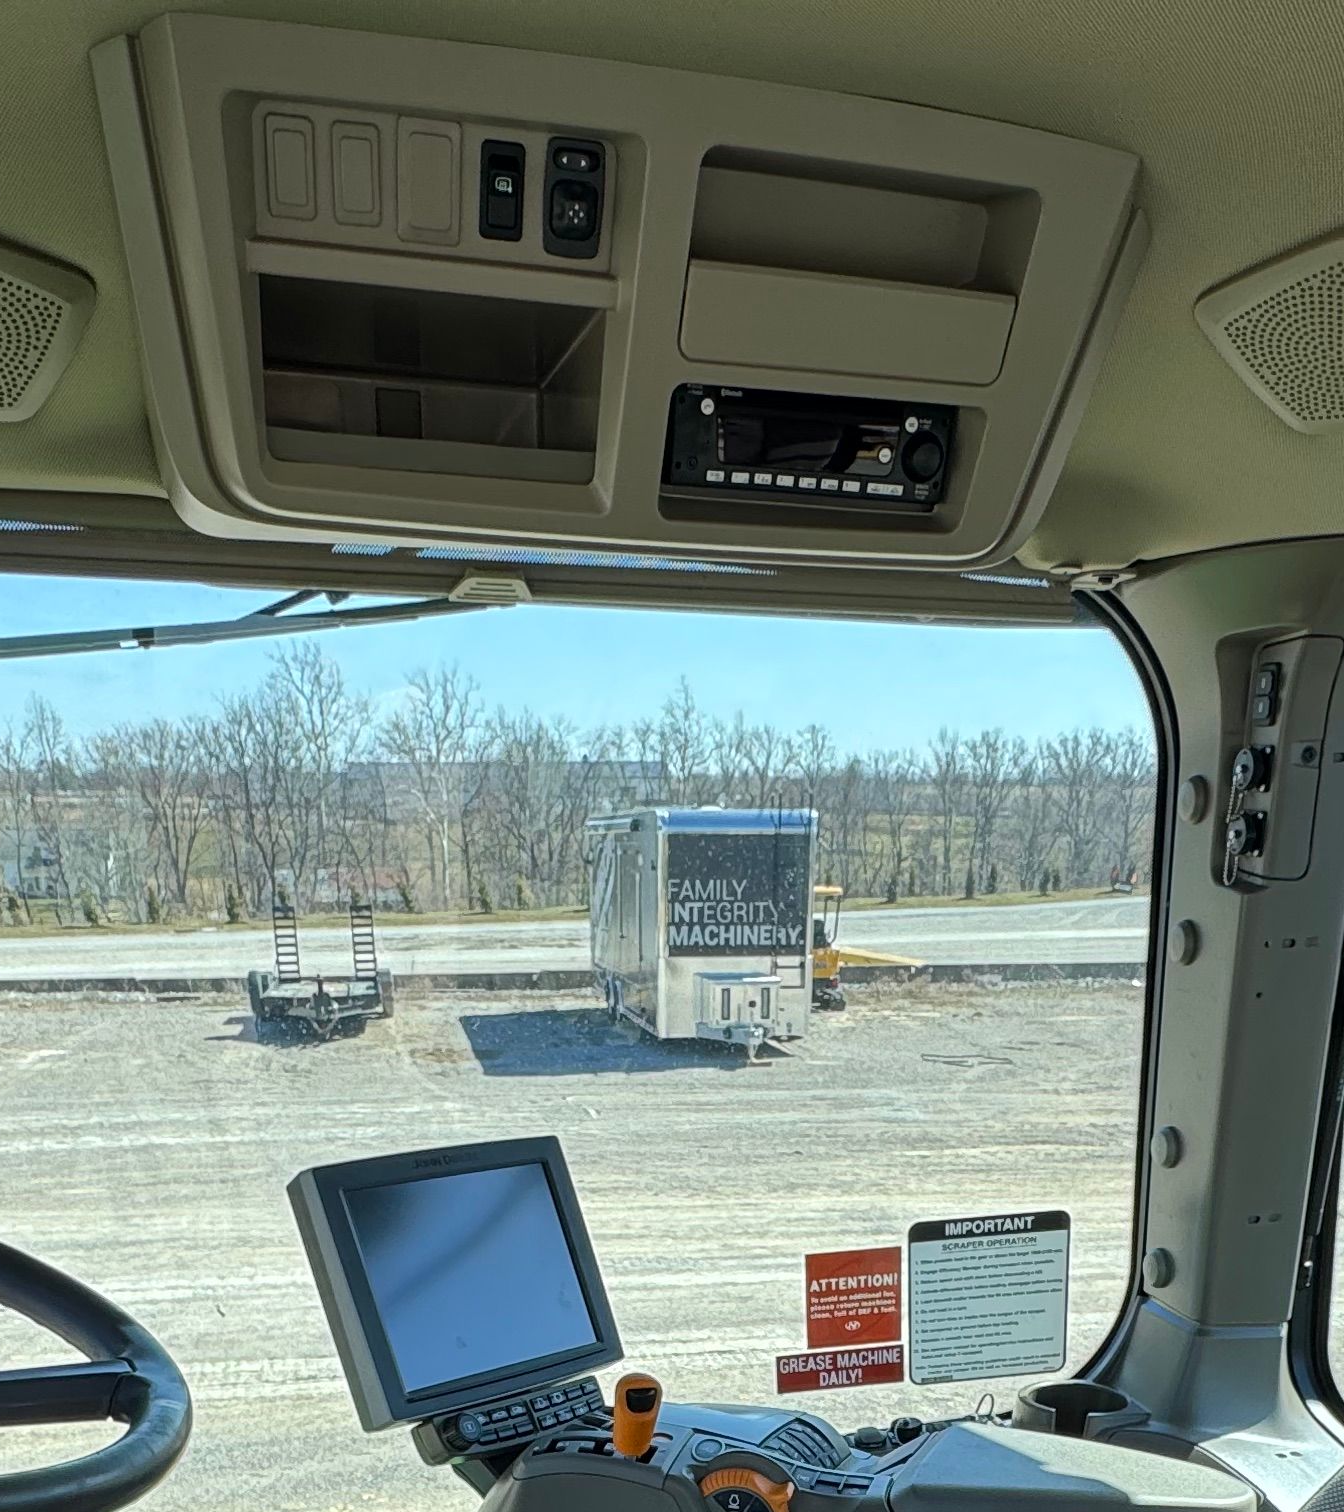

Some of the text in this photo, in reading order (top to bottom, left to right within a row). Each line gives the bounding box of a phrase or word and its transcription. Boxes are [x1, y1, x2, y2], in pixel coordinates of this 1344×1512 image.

[668, 879, 748, 901] FAMILY
[944, 1215, 1035, 1237] IMPORTANT
[941, 1235, 1038, 1252] SCRAPER OPERATION
[809, 1273, 898, 1292] ATTENTION!
[779, 1353, 834, 1375] GREASE
[836, 1347, 901, 1368] MACHINE
[819, 1368, 863, 1387] DAILY!
